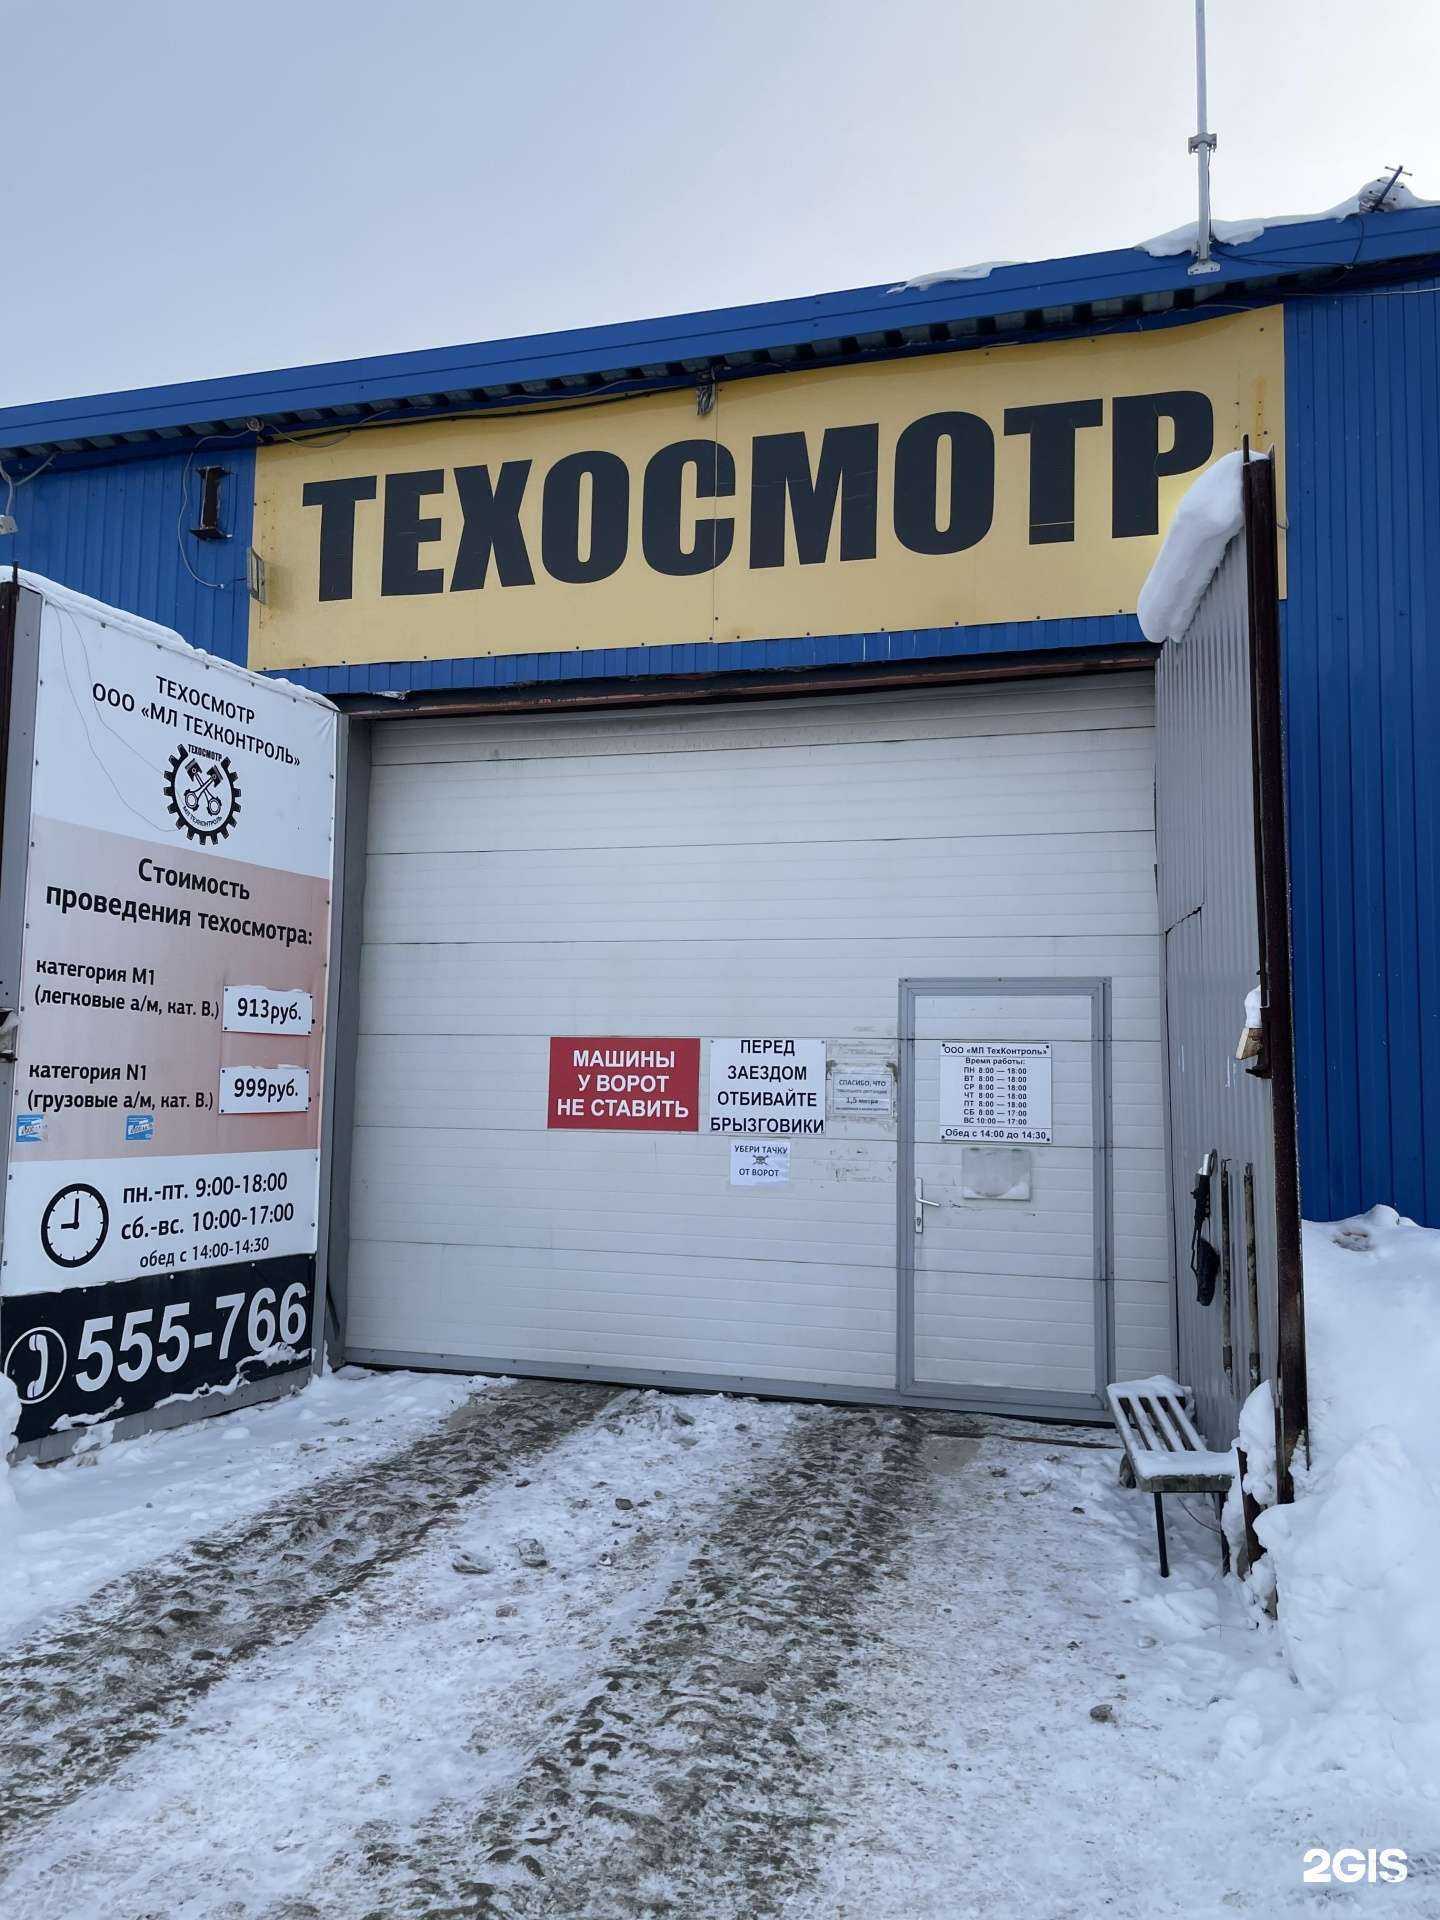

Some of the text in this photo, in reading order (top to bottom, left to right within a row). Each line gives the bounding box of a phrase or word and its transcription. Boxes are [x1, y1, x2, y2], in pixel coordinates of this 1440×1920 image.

[302, 389, 1214, 602] ТЕХОСМОТР
[156, 675, 255, 725] ТЕХОСМОТР
[92, 682, 301, 767] ООО «МЛ ТЕХКОНТРОЛЬ»
[188, 743, 222, 762] ТЕХОСМОТР
[138, 858, 250, 899] Стоимость
[46, 885, 313, 947] проведения техосмотра:
[36, 959, 126, 984] категория
[34, 985, 125, 1011] (легковые
[130, 994, 163, 1015] а/м,
[168, 1002, 196, 1016] кат.
[237, 997, 302, 1024] 913руб.
[572, 1049, 675, 1069] МАШИНЫ
[740, 1039, 795, 1057] ПЕРЕД
[944, 1046, 964, 1054] ООО
[965, 1057, 1026, 1066] Время работы:
[29, 1063, 147, 1084] категория N1
[578, 1074, 670, 1093] У ВОРОТ
[727, 1065, 807, 1083] ЗАЕЗДОМ
[27, 1089, 118, 1112] (грузовые
[124, 1091, 156, 1111] а/м,
[161, 1095, 190, 1108] кат.
[234, 1078, 299, 1102] 999руб.
[717, 1087, 817, 1108] ОТБИВАЙТЕ
[557, 1098, 689, 1119] НЕ СТАВИТЬ
[711, 1116, 825, 1135] БРЫЗГОВИКИ
[945, 1128, 969, 1138] Обед
[980, 1130, 1004, 1138] 14:00
[1006, 1132, 1018, 1140] до
[1022, 1131, 1046, 1140] 14:30
[734, 1145, 788, 1154] УБЕРИ ТАЧКУ
[738, 1168, 780, 1177] ОТ ВОРОТ
[123, 1172, 288, 1204] пн.-пт. 9:00-18:00
[121, 1203, 294, 1240] сб.-вс. 10:00-17:00
[140, 1236, 270, 1268] обед с 14:00-14:30
[75, 1282, 307, 1392] 555-766
